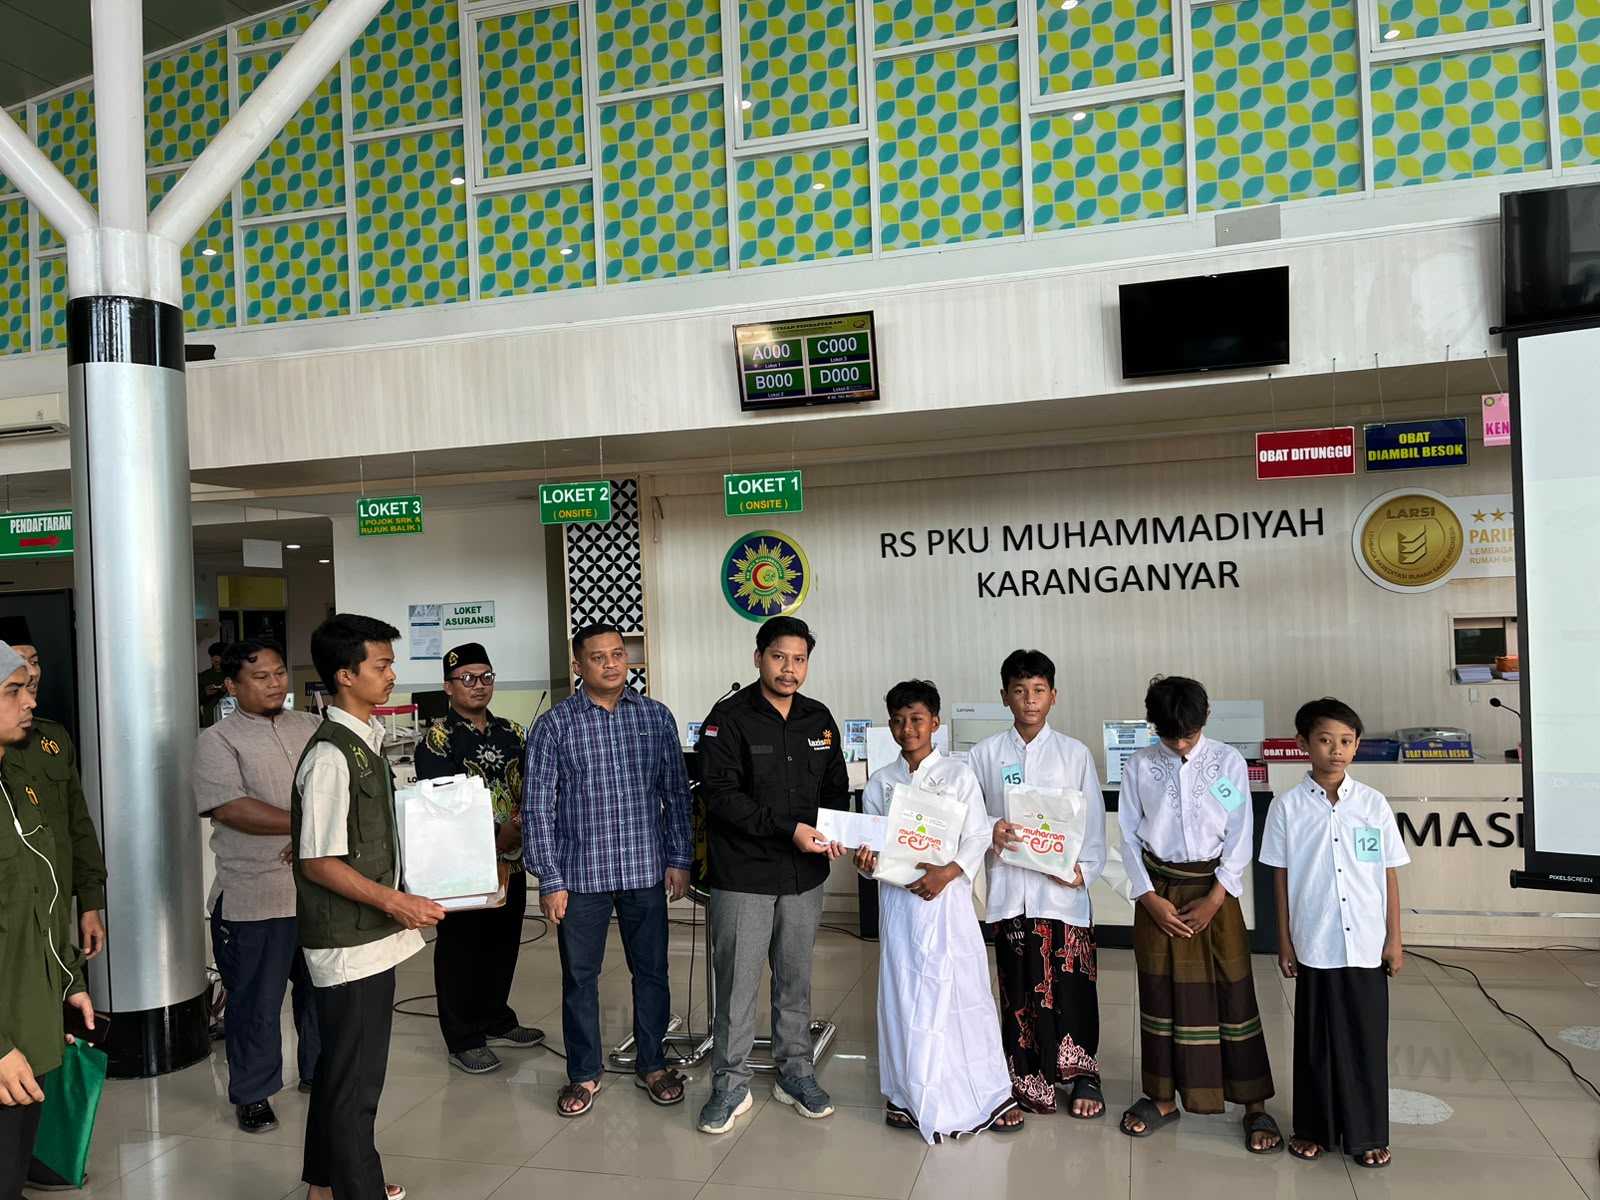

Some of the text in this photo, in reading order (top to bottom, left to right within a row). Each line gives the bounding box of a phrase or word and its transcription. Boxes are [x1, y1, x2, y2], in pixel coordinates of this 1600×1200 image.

[752, 344, 790, 360] A000
[817, 336, 857, 354] C000
[756, 373, 792, 389] B000
[820, 367, 859, 384] D000
[1486, 422, 1510, 435] KEN
[1399, 432, 1431, 444] OBAT
[1260, 445, 1351, 462] OBAT DITUNGGU
[1368, 444, 1463, 461] DIAMBIL BESOK
[728, 476, 798, 494] LOKET 1
[543, 487, 608, 504] LOKET 2
[360, 501, 420, 517] LOKET 3
[1386, 506, 1435, 519] LARSI
[10, 516, 71, 534] PENDAFTARAN
[880, 507, 1324, 558] RS PKU MUHAMMADIYAH
[1470, 546, 1514, 555] LEMBAGA
[1470, 556, 1500, 564] RUMAH
[977, 560, 1240, 598] KARANGANYAR
[454, 606, 482, 615] LOKET
[445, 616, 493, 626] ASURANSI
[1004, 773, 1021, 784] 15
[1217, 784, 1232, 798] 5
[1023, 828, 1065, 841] muharram
[1358, 837, 1378, 852] 12
[1549, 874, 1593, 883] PIXELSCREEN
